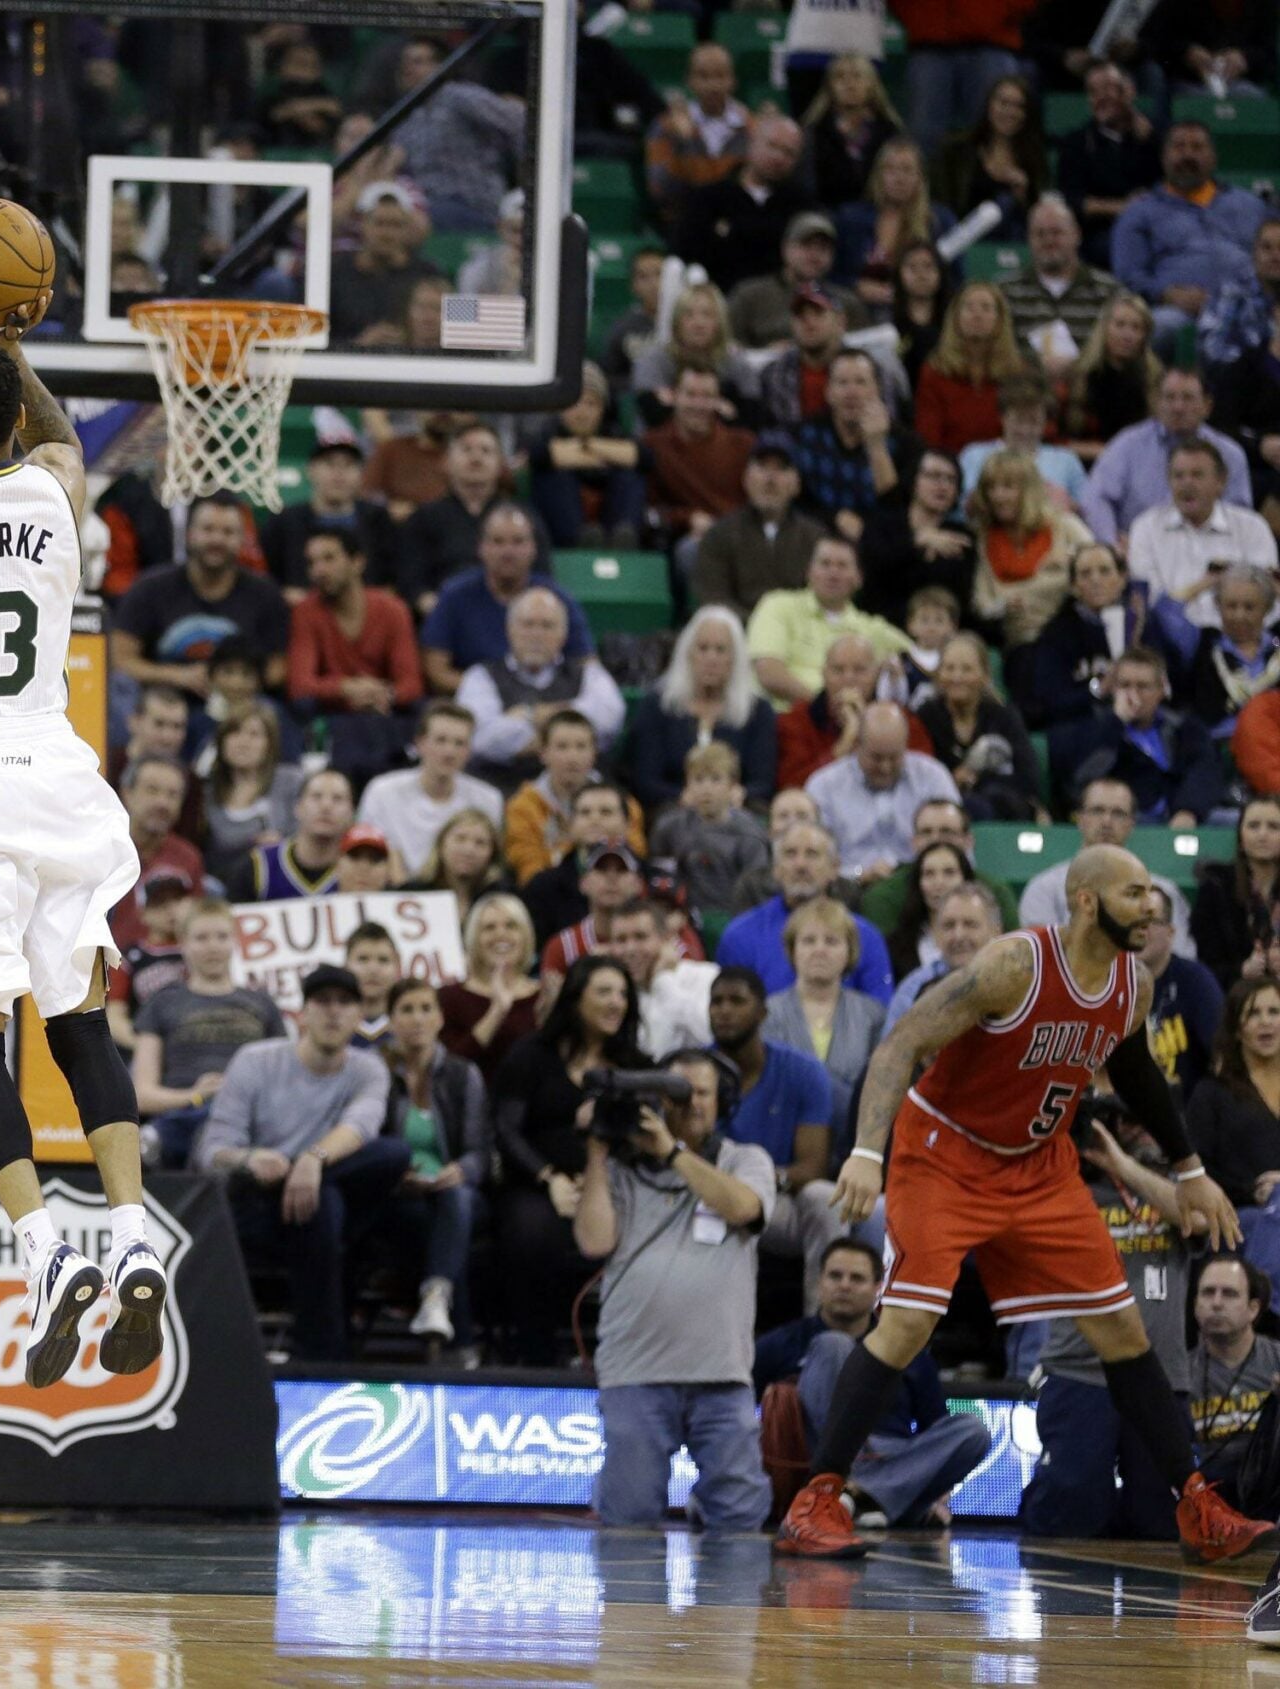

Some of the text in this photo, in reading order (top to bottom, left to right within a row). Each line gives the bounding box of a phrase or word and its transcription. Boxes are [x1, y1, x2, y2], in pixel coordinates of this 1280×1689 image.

[1, 755, 32, 767] UTAH
[1019, 1021, 1118, 1070] BULLS
[1028, 1081, 1077, 1139] 5
[448, 1412, 608, 1455] WAS
